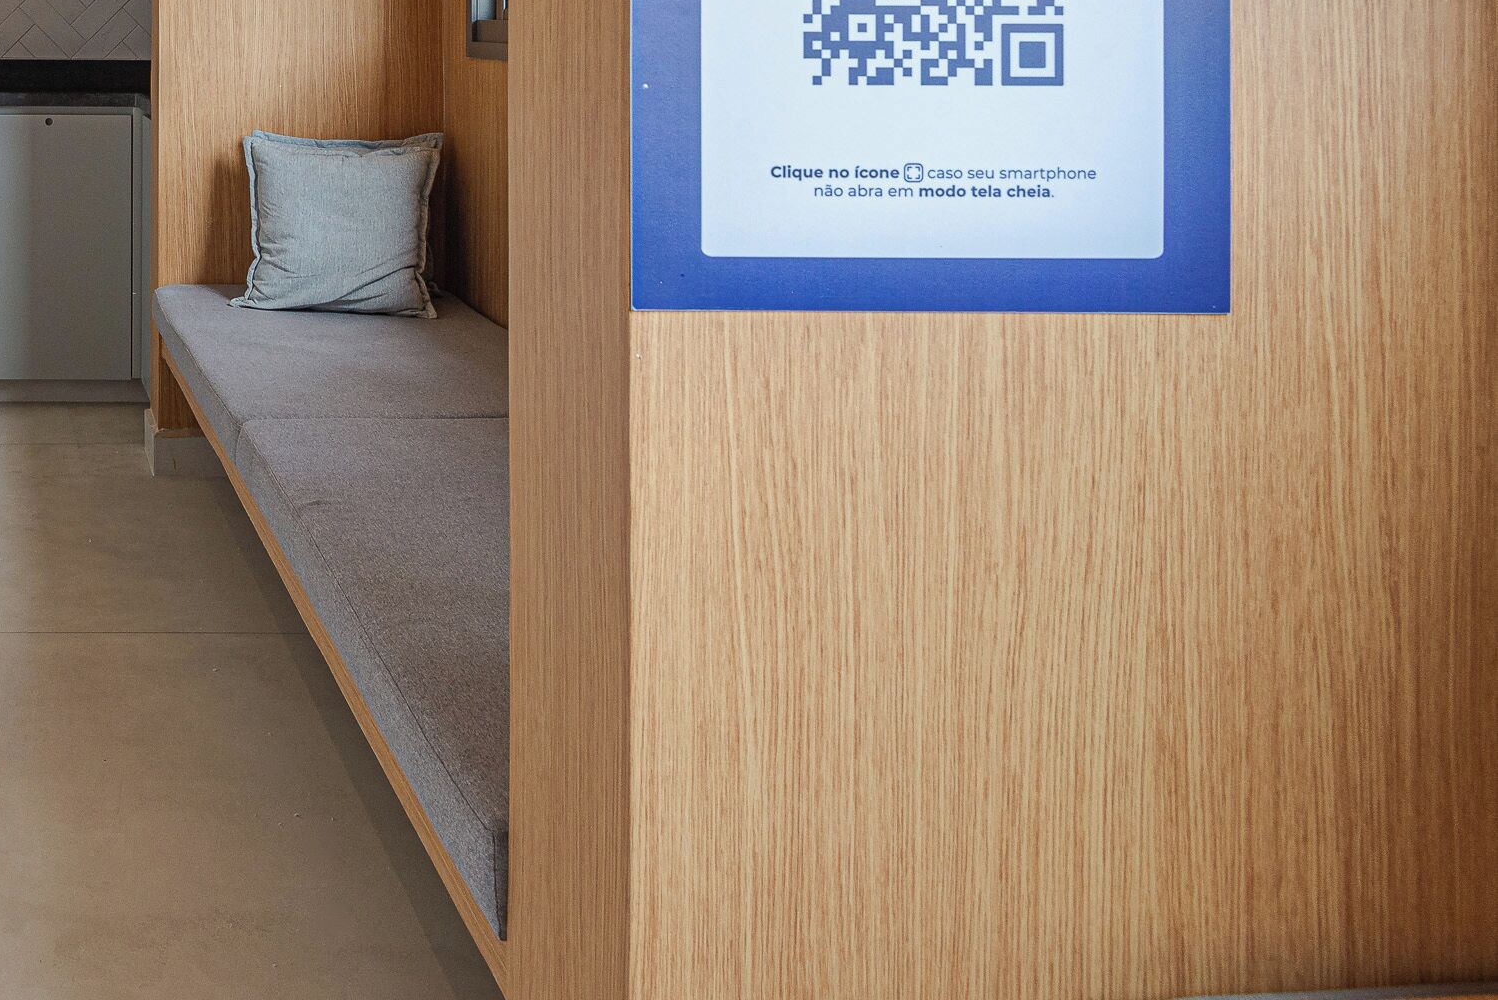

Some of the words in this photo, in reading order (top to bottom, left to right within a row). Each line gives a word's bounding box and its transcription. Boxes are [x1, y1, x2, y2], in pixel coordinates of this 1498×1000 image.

[770, 164, 824, 182] Clique
[828, 168, 850, 179] no
[854, 164, 901, 180] ícone
[926, 168, 964, 180] caso
[966, 168, 995, 180] seu
[998, 165, 1098, 183] smartphone
[813, 183, 844, 198] não
[847, 183, 884, 198] abra
[887, 186, 914, 198] em
[918, 184, 967, 198] modo
[970, 184, 1002, 199] tela
[1006, 183, 1055, 199] cheia.
